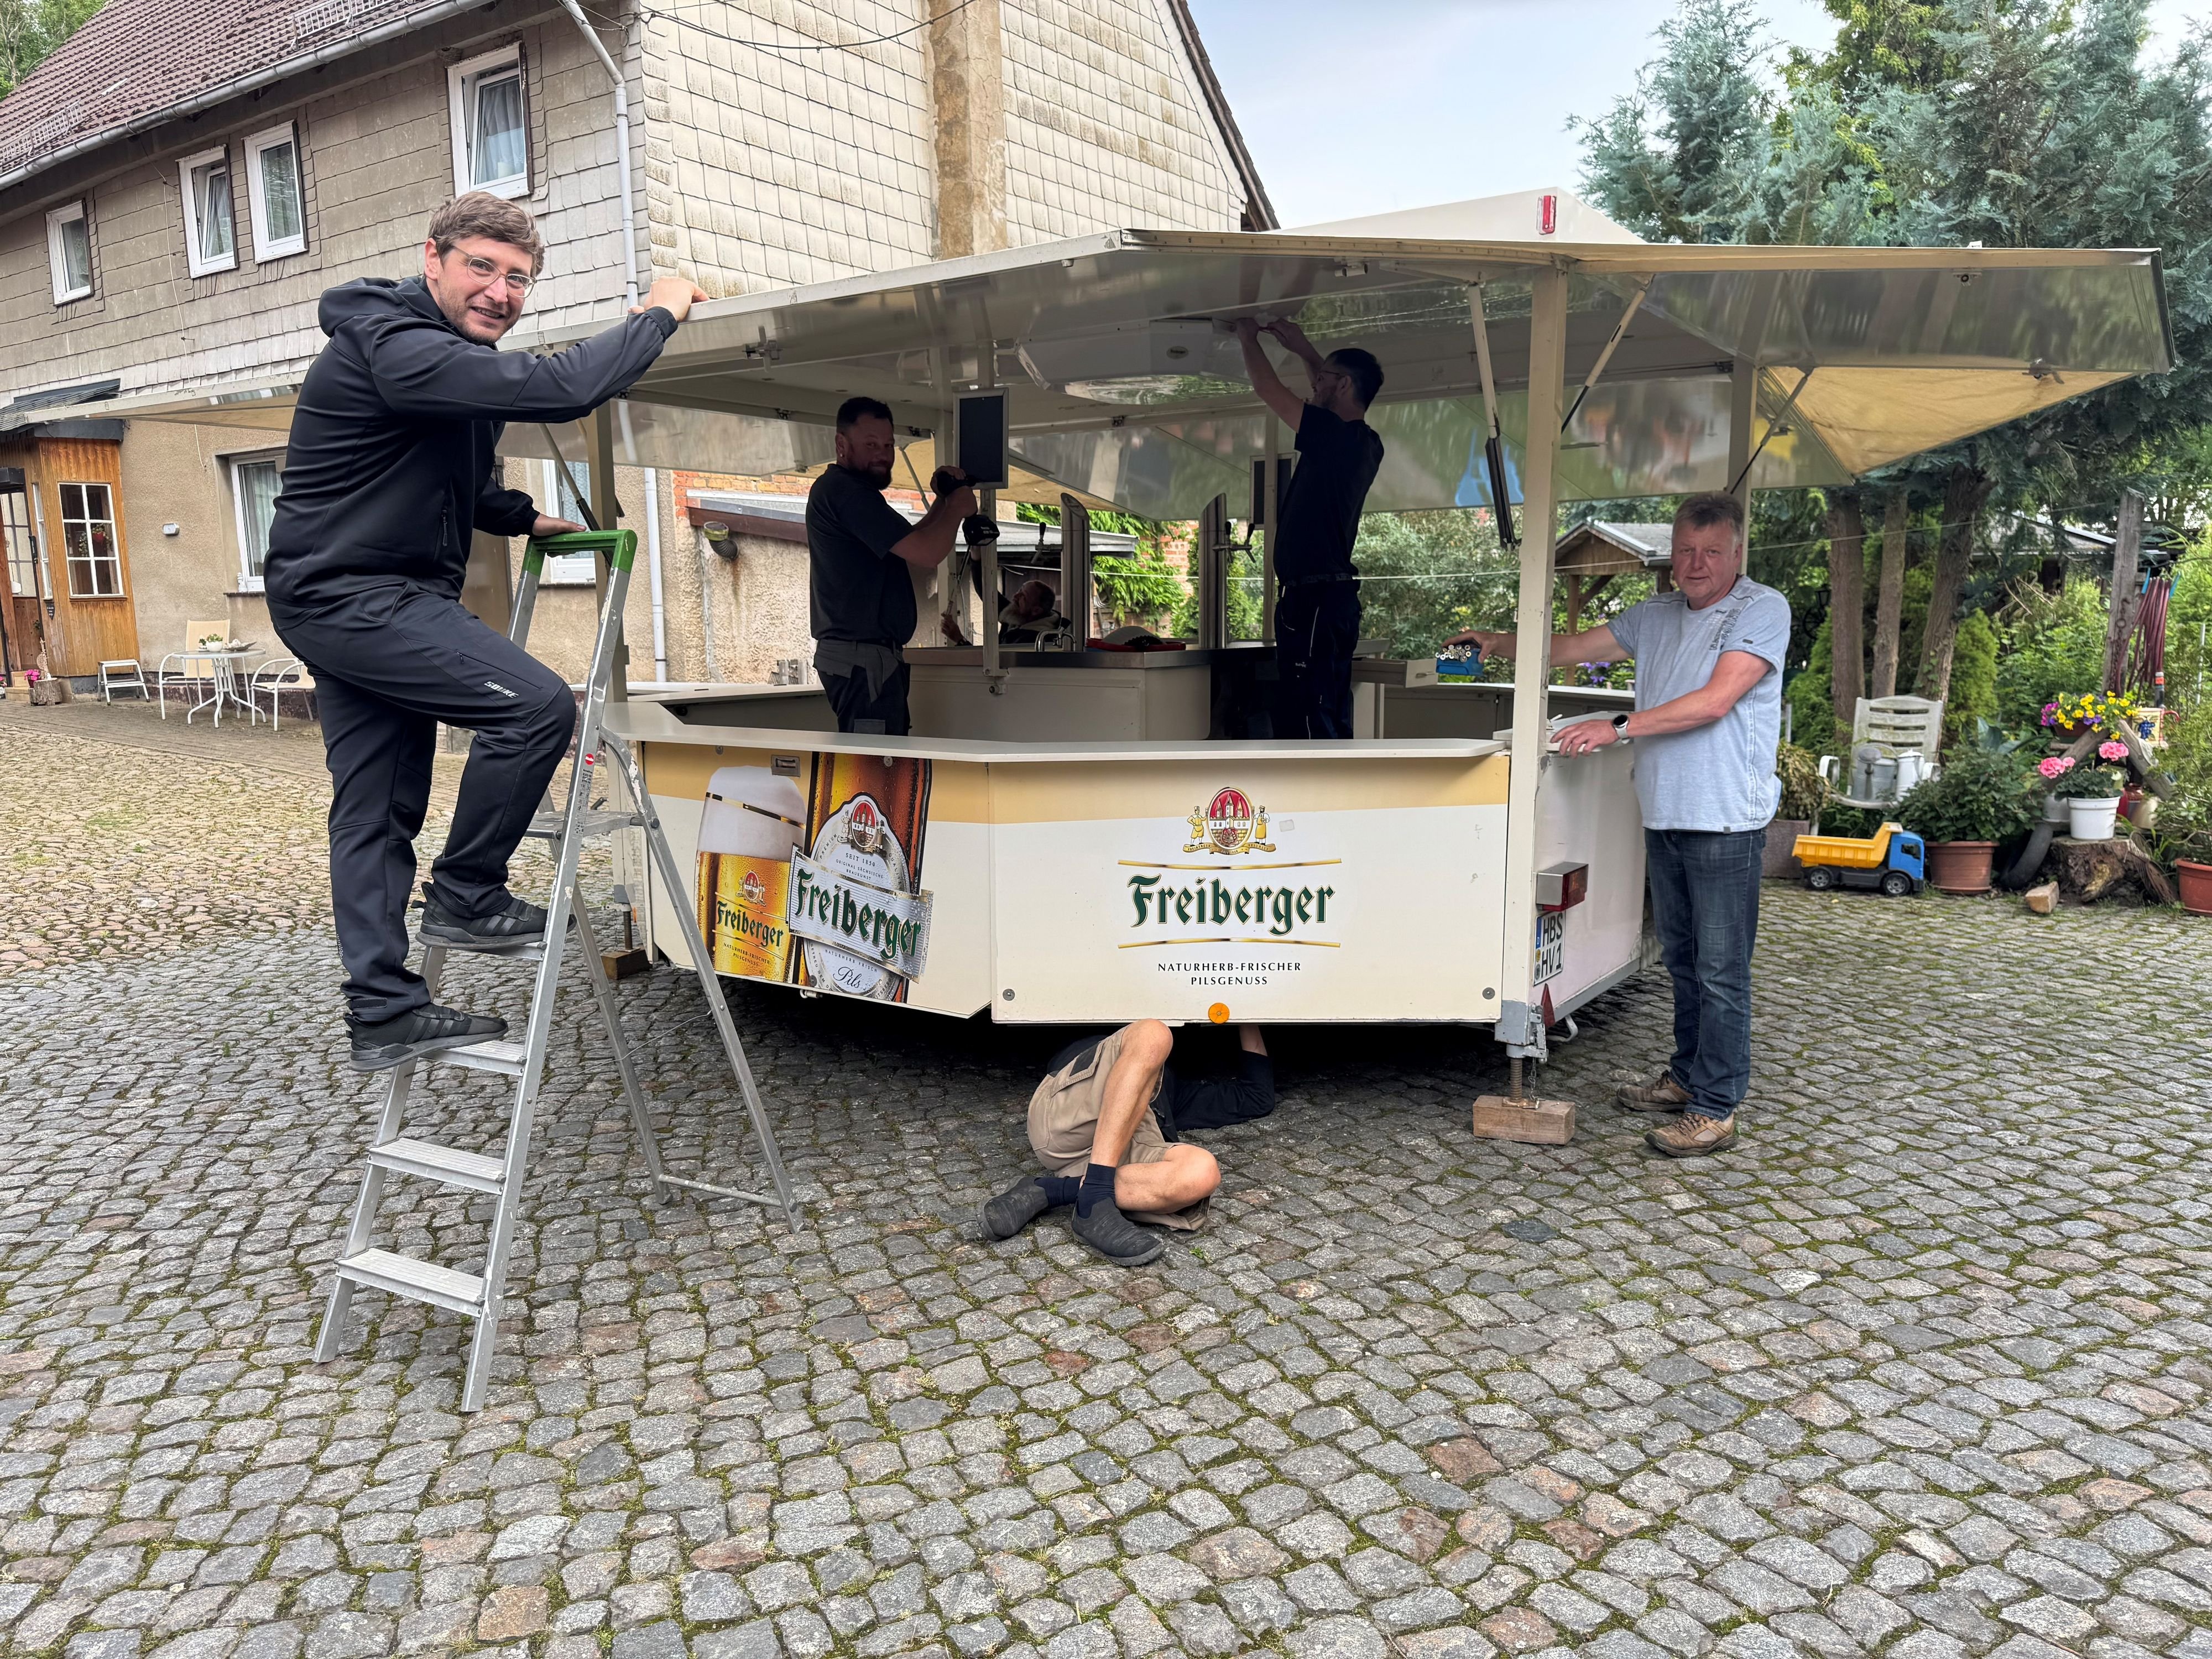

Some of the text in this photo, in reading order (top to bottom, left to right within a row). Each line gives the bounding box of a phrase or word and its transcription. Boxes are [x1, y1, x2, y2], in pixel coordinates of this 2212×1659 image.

[483, 681, 519, 698] SOUKE
[820, 833, 838, 859] PREMIUM
[836, 859, 855, 869] ORIGINAL
[846, 853, 875, 867] SEIT 1850
[795, 868, 922, 959] Freiberger
[1127, 873, 1335, 936] Freiberger
[717, 900, 784, 947] Freiberger
[1542, 912, 1563, 947] HBS
[723, 942, 771, 964] NATURHERB-FRISCHER
[733, 952, 759, 966] PILSGENUSS
[825, 949, 877, 973] NATURHERB FRISCH
[1541, 942, 1562, 978] HV 1
[833, 966, 862, 988] Pils
[1158, 962, 1301, 972] NATURHERB-FRISCHER
[1191, 976, 1268, 985] PILSGENUSS
